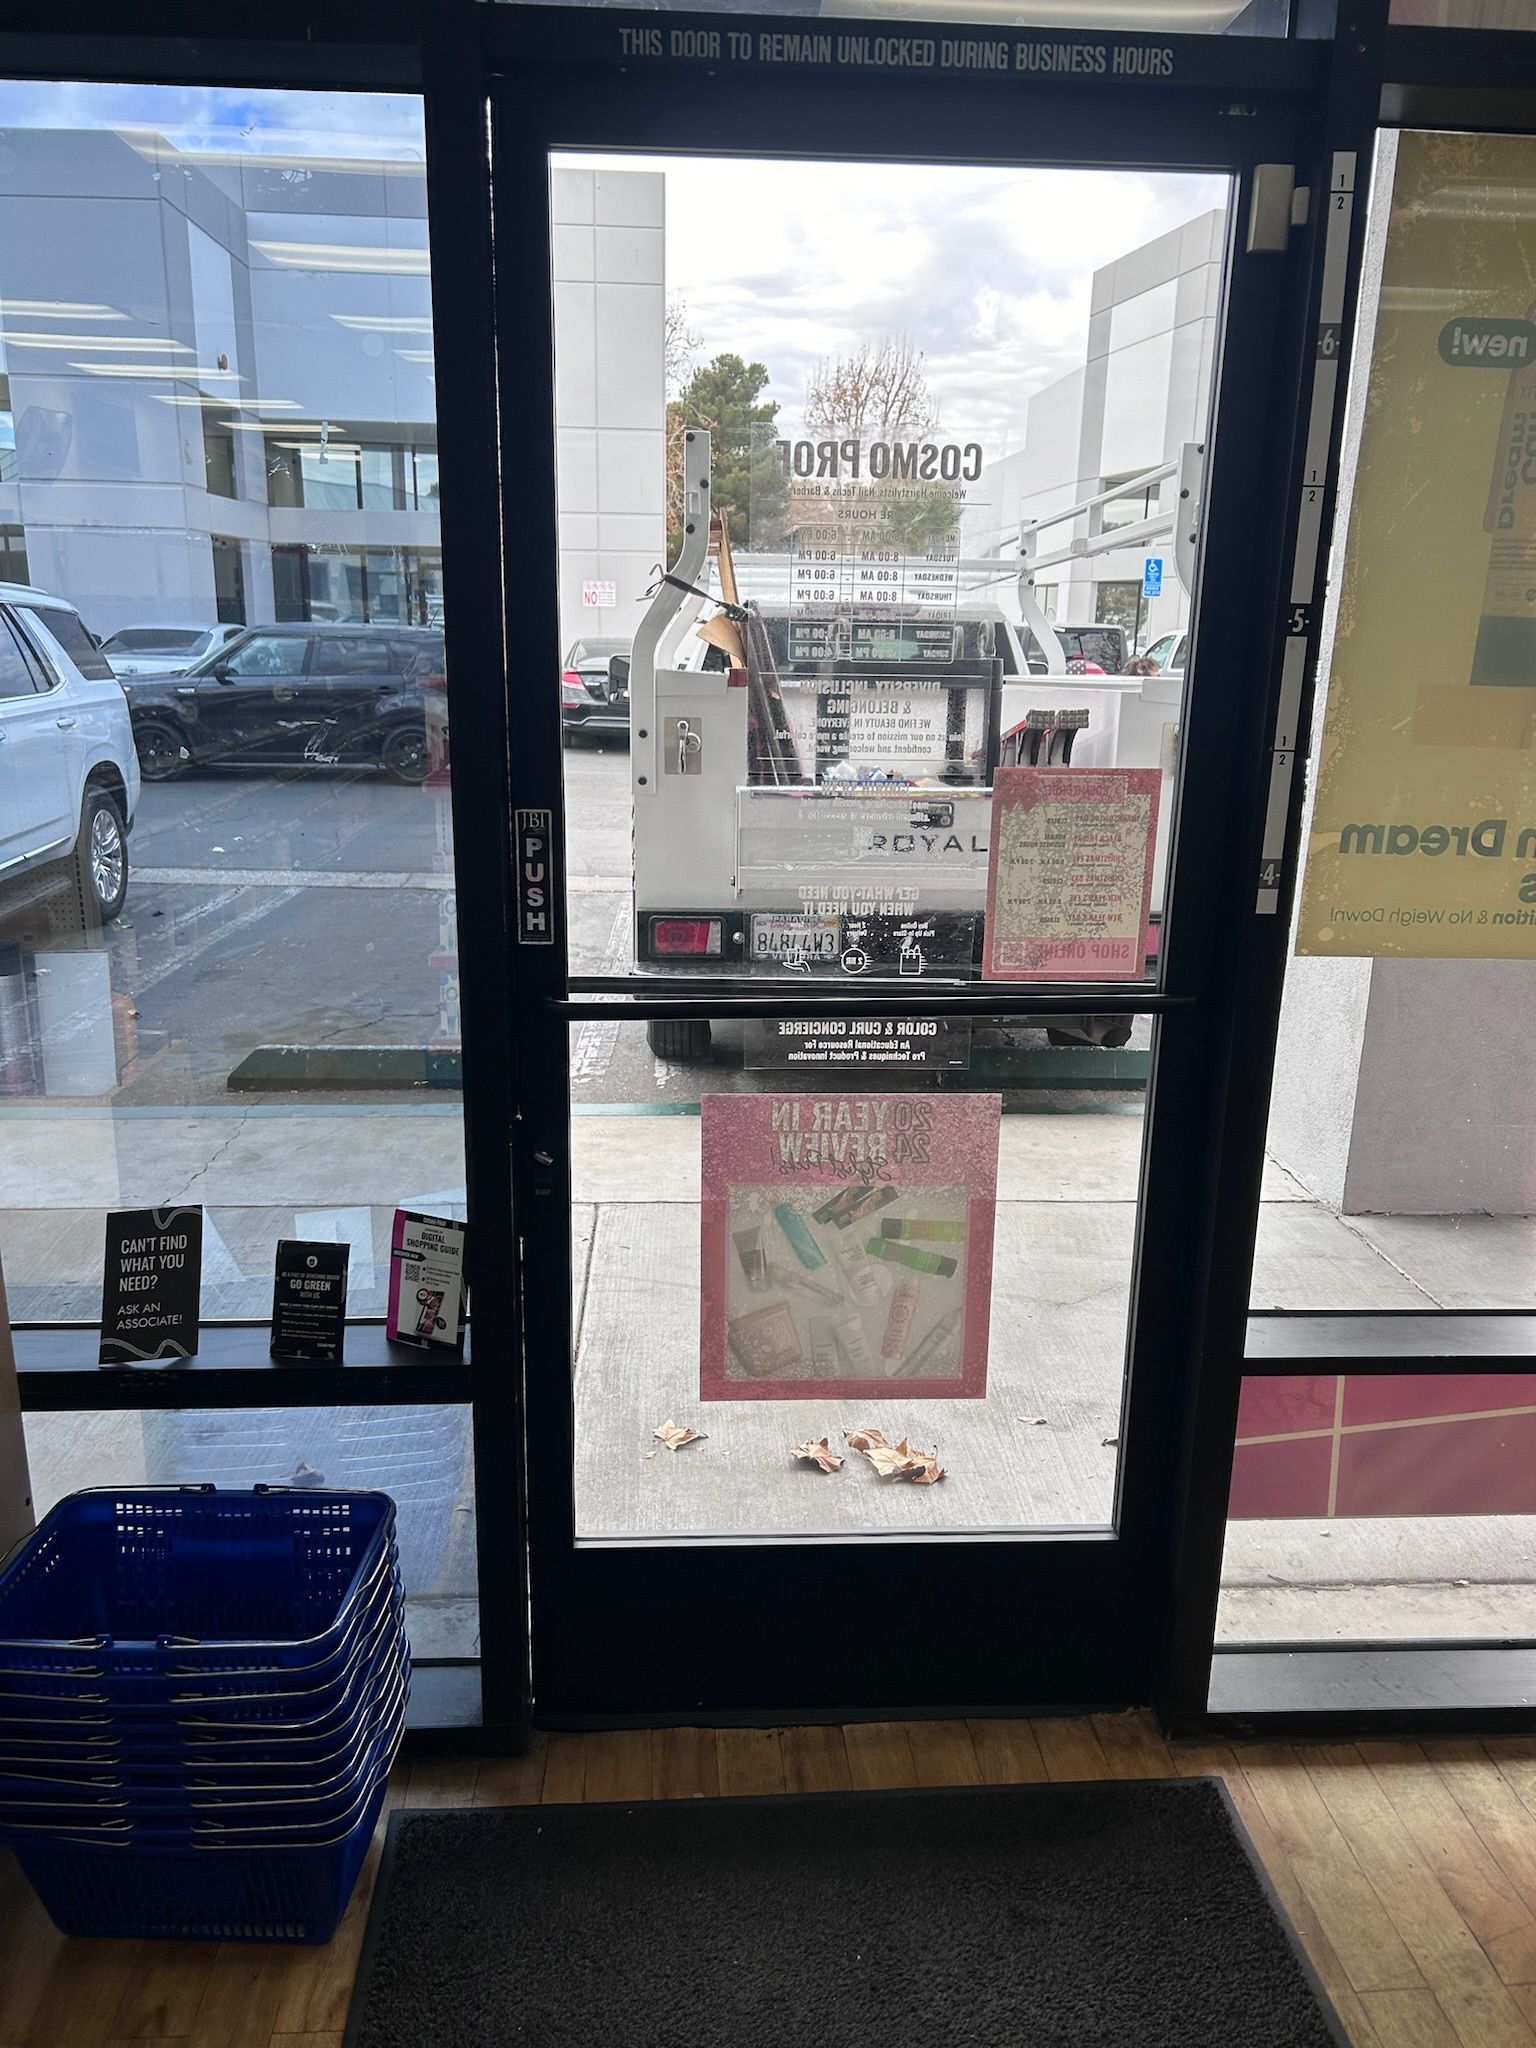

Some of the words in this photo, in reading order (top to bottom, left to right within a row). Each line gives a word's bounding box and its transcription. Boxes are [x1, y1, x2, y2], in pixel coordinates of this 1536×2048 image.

[619, 28, 663, 57] THIS
[671, 30, 721, 58] DOOR
[727, 32, 752, 60] TO
[760, 33, 831, 64] REMAIN
[836, 36, 935, 67] UNLOCKED
[940, 40, 1009, 70] DURING
[1015, 43, 1106, 74] BUSINESS
[1112, 47, 1174, 76] HOURS
[584, 591, 598, 605] NO
[521, 811, 545, 831] JBI
[525, 838, 546, 931] PUSH
[121, 1237, 157, 1254] CAN'T
[159, 1234, 188, 1251] FIND
[421, 1231, 445, 1244] DIGITAL
[406, 1238, 439, 1252] SHOPPING
[439, 1244, 460, 1256] GUIDE
[120, 1256, 157, 1274] WHAT
[158, 1253, 185, 1270] YOU
[119, 1274, 159, 1292] NEED?
[290, 1279, 302, 1290] GO
[304, 1280, 331, 1291] GREEN
[117, 1303, 140, 1316] ASK
[142, 1302, 161, 1313] AN
[116, 1314, 183, 1331] ASSOCIATE!
